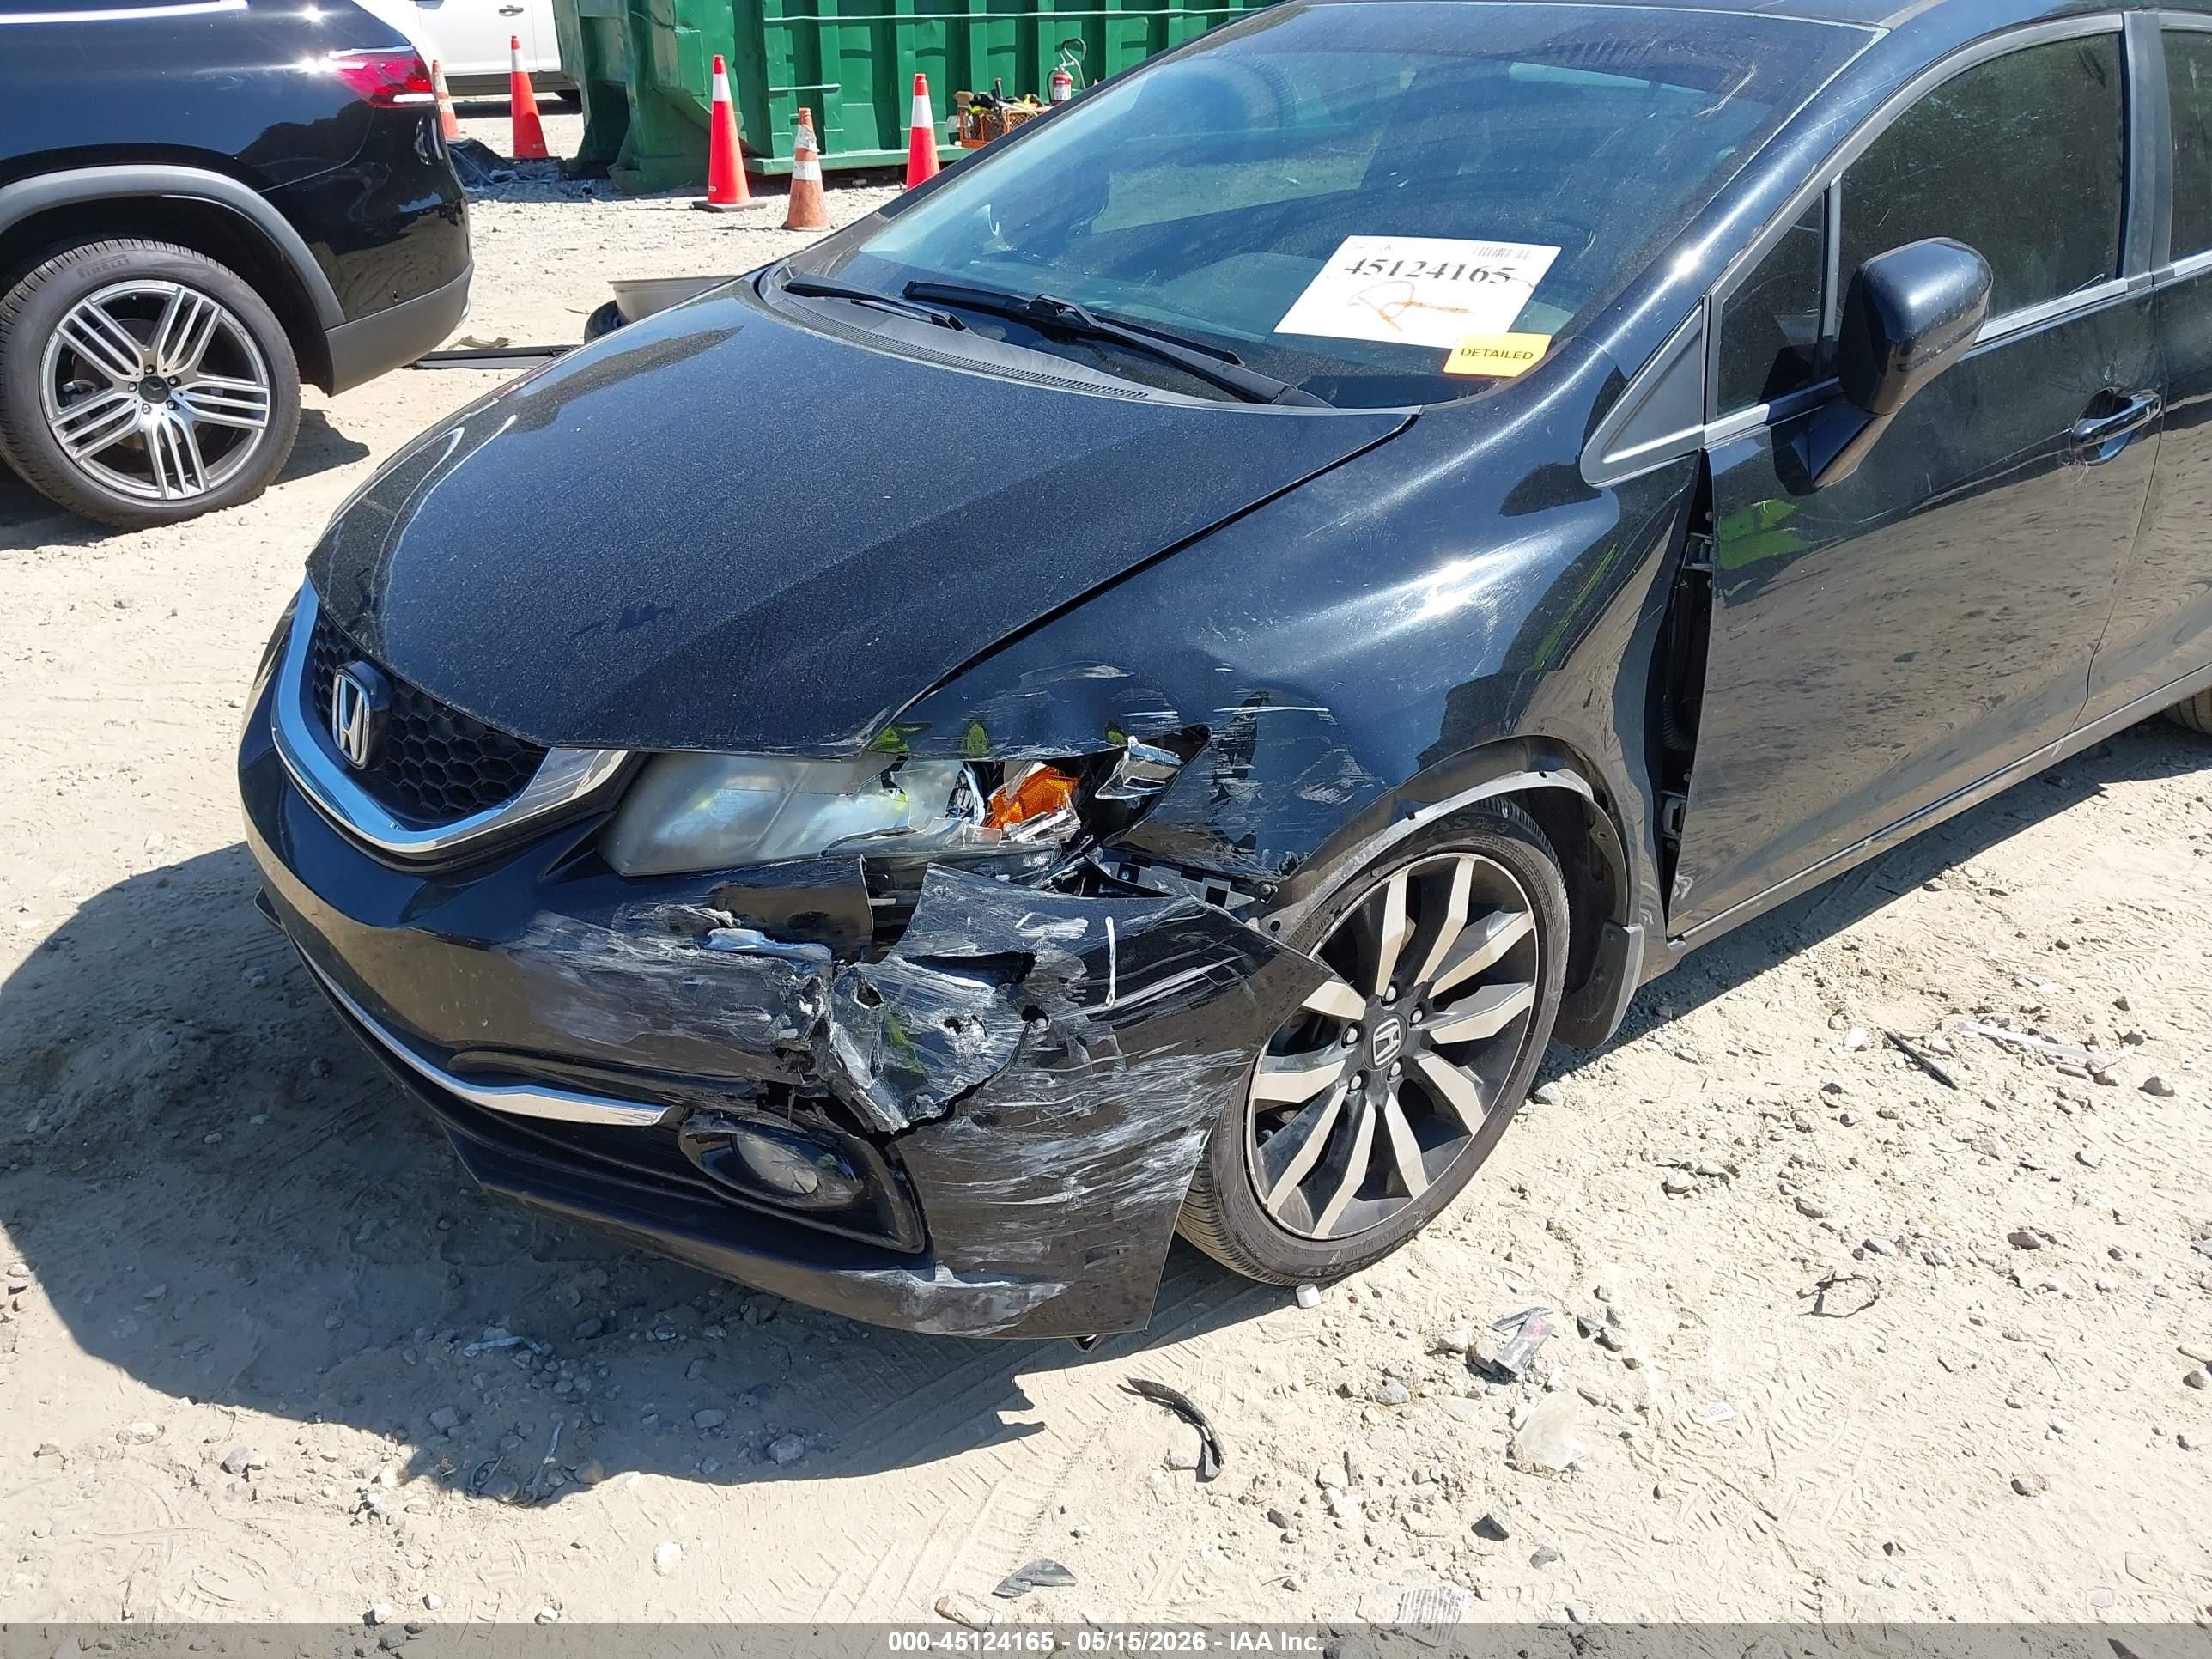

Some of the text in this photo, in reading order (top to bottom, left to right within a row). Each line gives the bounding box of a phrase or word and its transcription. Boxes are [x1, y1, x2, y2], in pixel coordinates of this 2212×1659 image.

[76, 253, 131, 279] PIRELLI
[1345, 258, 1516, 284] 45124165
[1461, 348, 1534, 360] DETAILED
